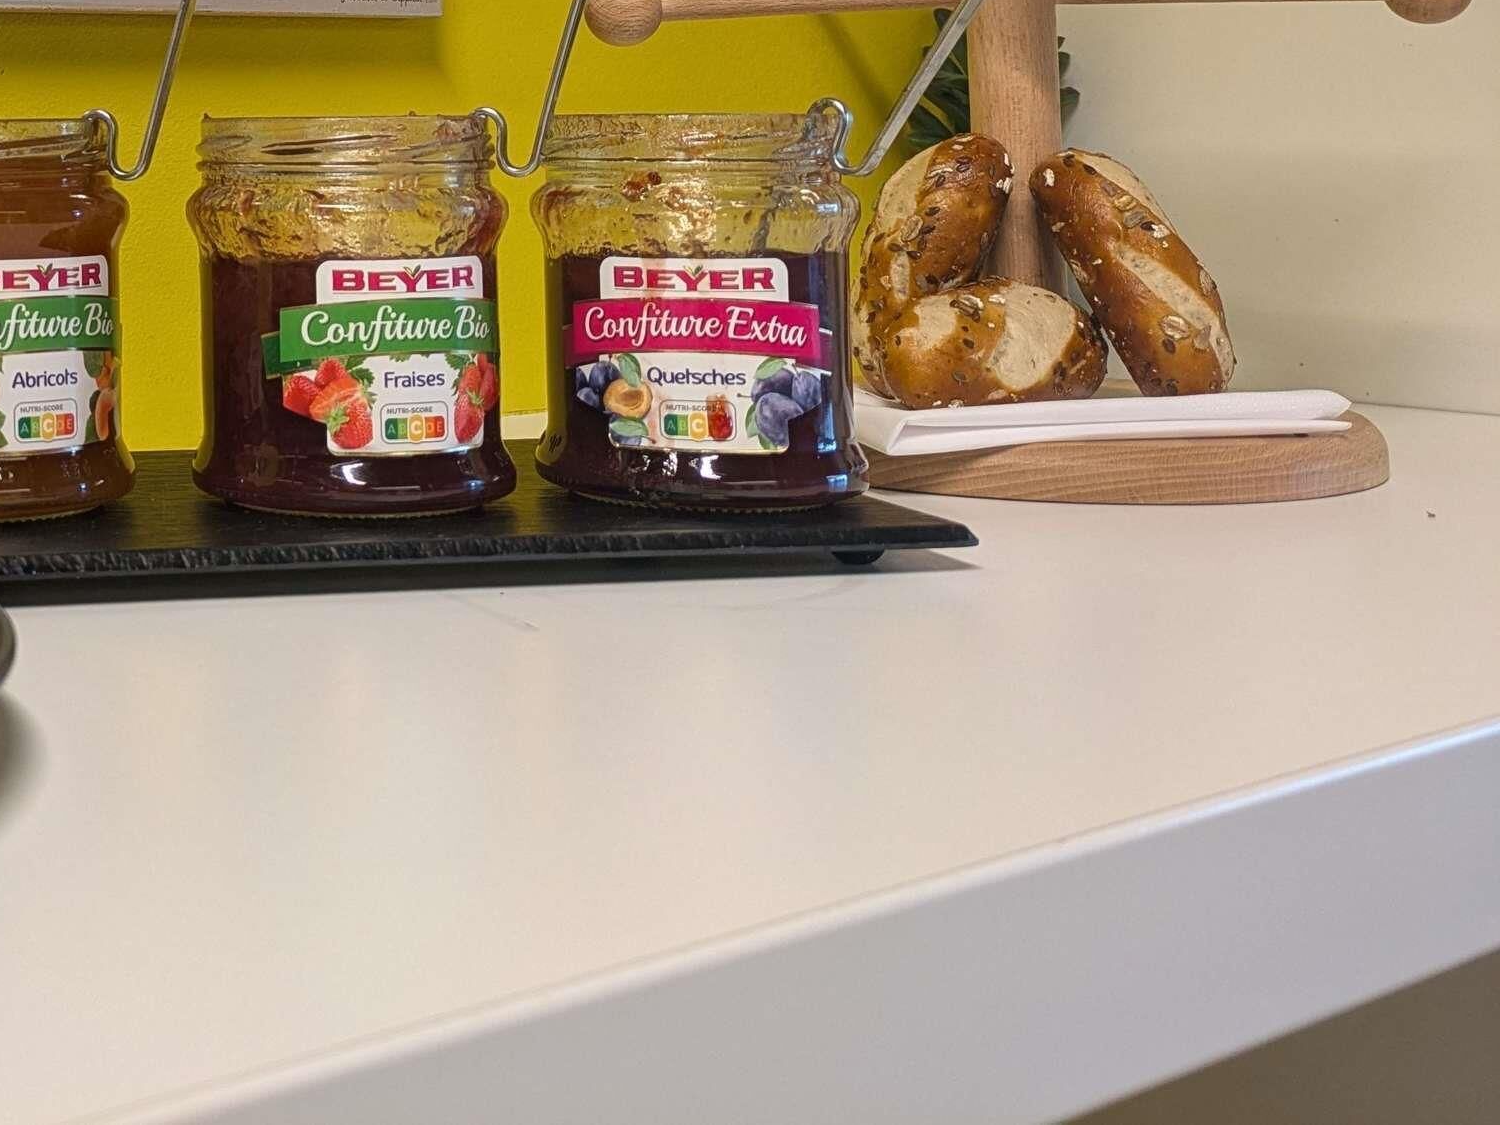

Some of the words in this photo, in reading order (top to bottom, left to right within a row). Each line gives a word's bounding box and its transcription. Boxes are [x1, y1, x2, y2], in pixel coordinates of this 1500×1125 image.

[332, 265, 475, 293] BEYER
[613, 264, 776, 291] BEYER
[84, 303, 114, 337] Bio
[301, 305, 453, 352] Confiture
[454, 305, 491, 339] Bio
[585, 302, 723, 347] Confiture
[726, 305, 807, 347] Extra
[11, 368, 78, 389] Abricots
[384, 371, 445, 389] Fraises
[647, 366, 746, 386] Quetsches
[20, 403, 64, 413] NUTRI-SCORE
[387, 405, 433, 414] NUTRI-SCORE
